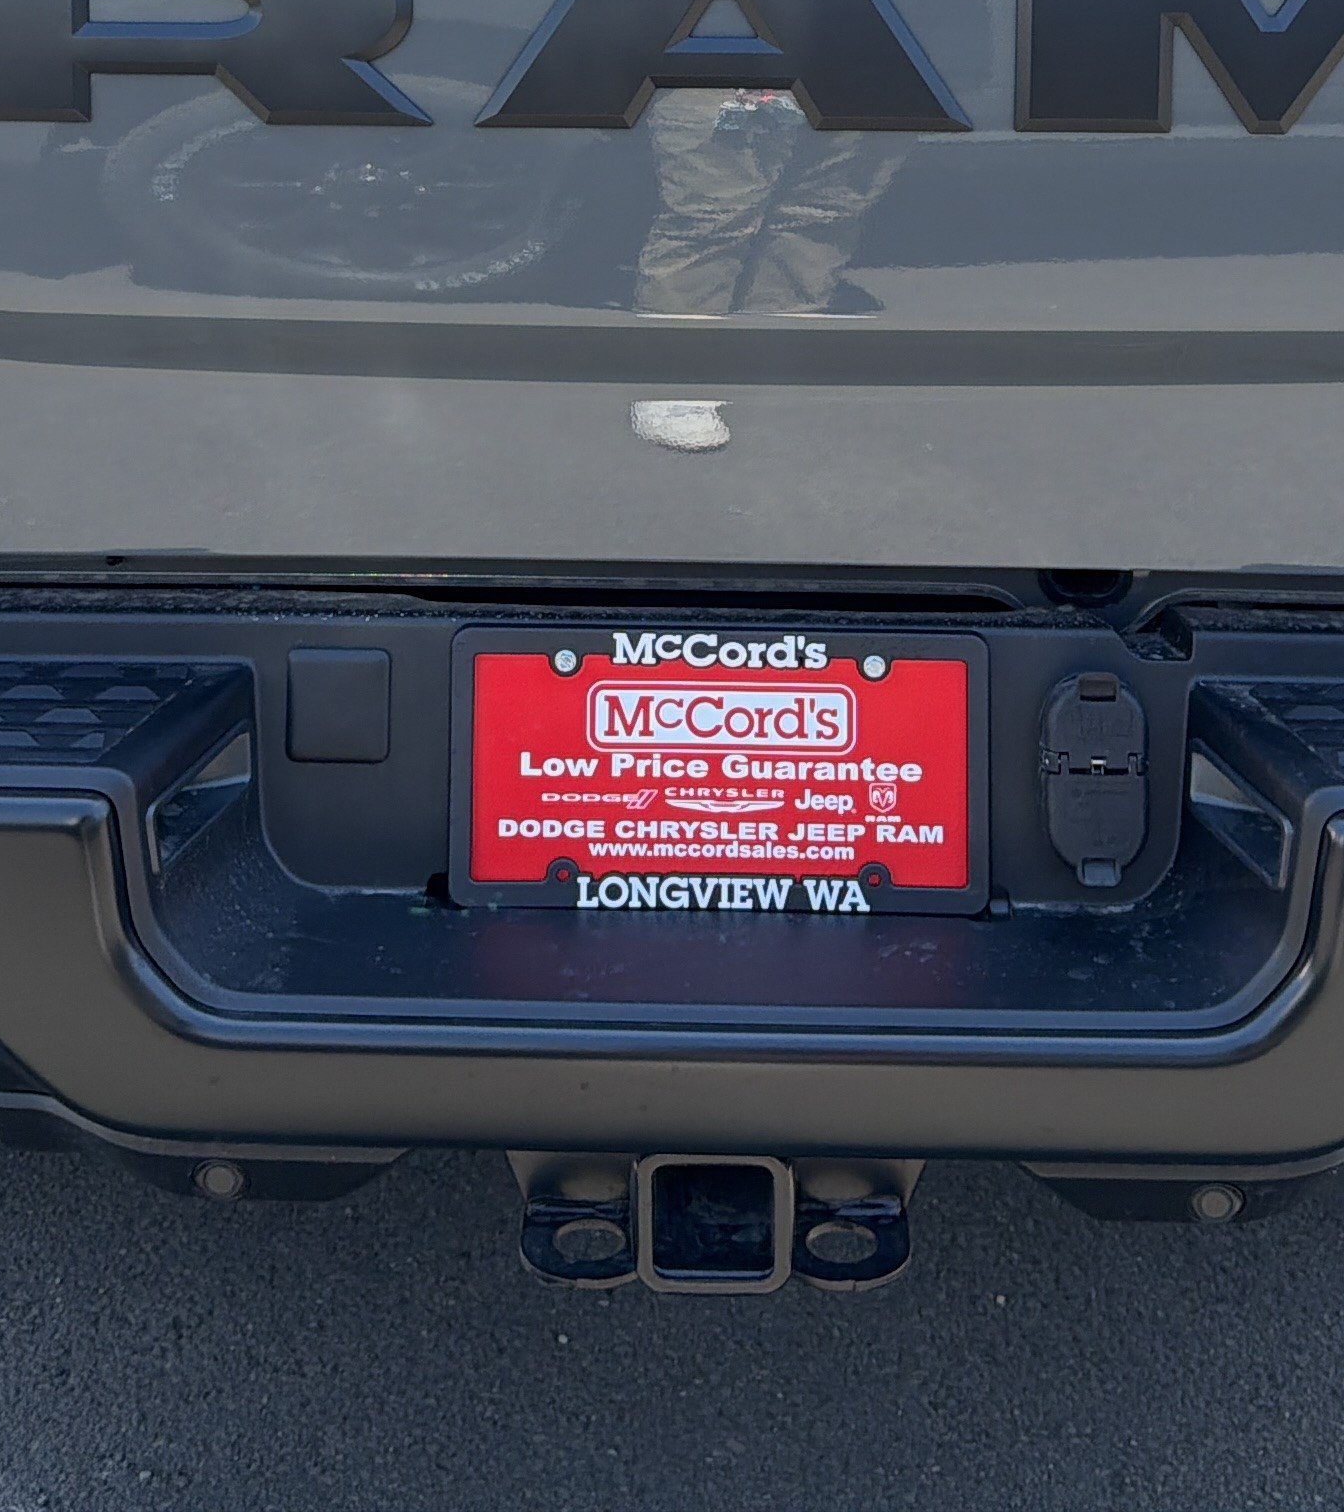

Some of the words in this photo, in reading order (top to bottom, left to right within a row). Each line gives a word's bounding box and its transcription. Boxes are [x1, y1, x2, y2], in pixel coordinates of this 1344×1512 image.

[612, 631, 829, 671] McCord's
[602, 694, 841, 741] McCord's
[519, 751, 599, 778] Low
[610, 752, 709, 779] Price
[721, 753, 923, 783] Guarantee
[541, 791, 637, 803] DODGE
[664, 786, 786, 799] CHRYSLER
[794, 788, 855, 815] Jeep
[497, 818, 606, 839] DODGE
[613, 820, 779, 842] CHRYSLER
[787, 823, 866, 843] JEEP
[875, 824, 945, 845] RAM
[864, 814, 901, 823] RAM
[587, 841, 856, 861] www.mccordsales.com
[576, 876, 794, 911] LONGVIEW
[803, 879, 871, 913] WA
